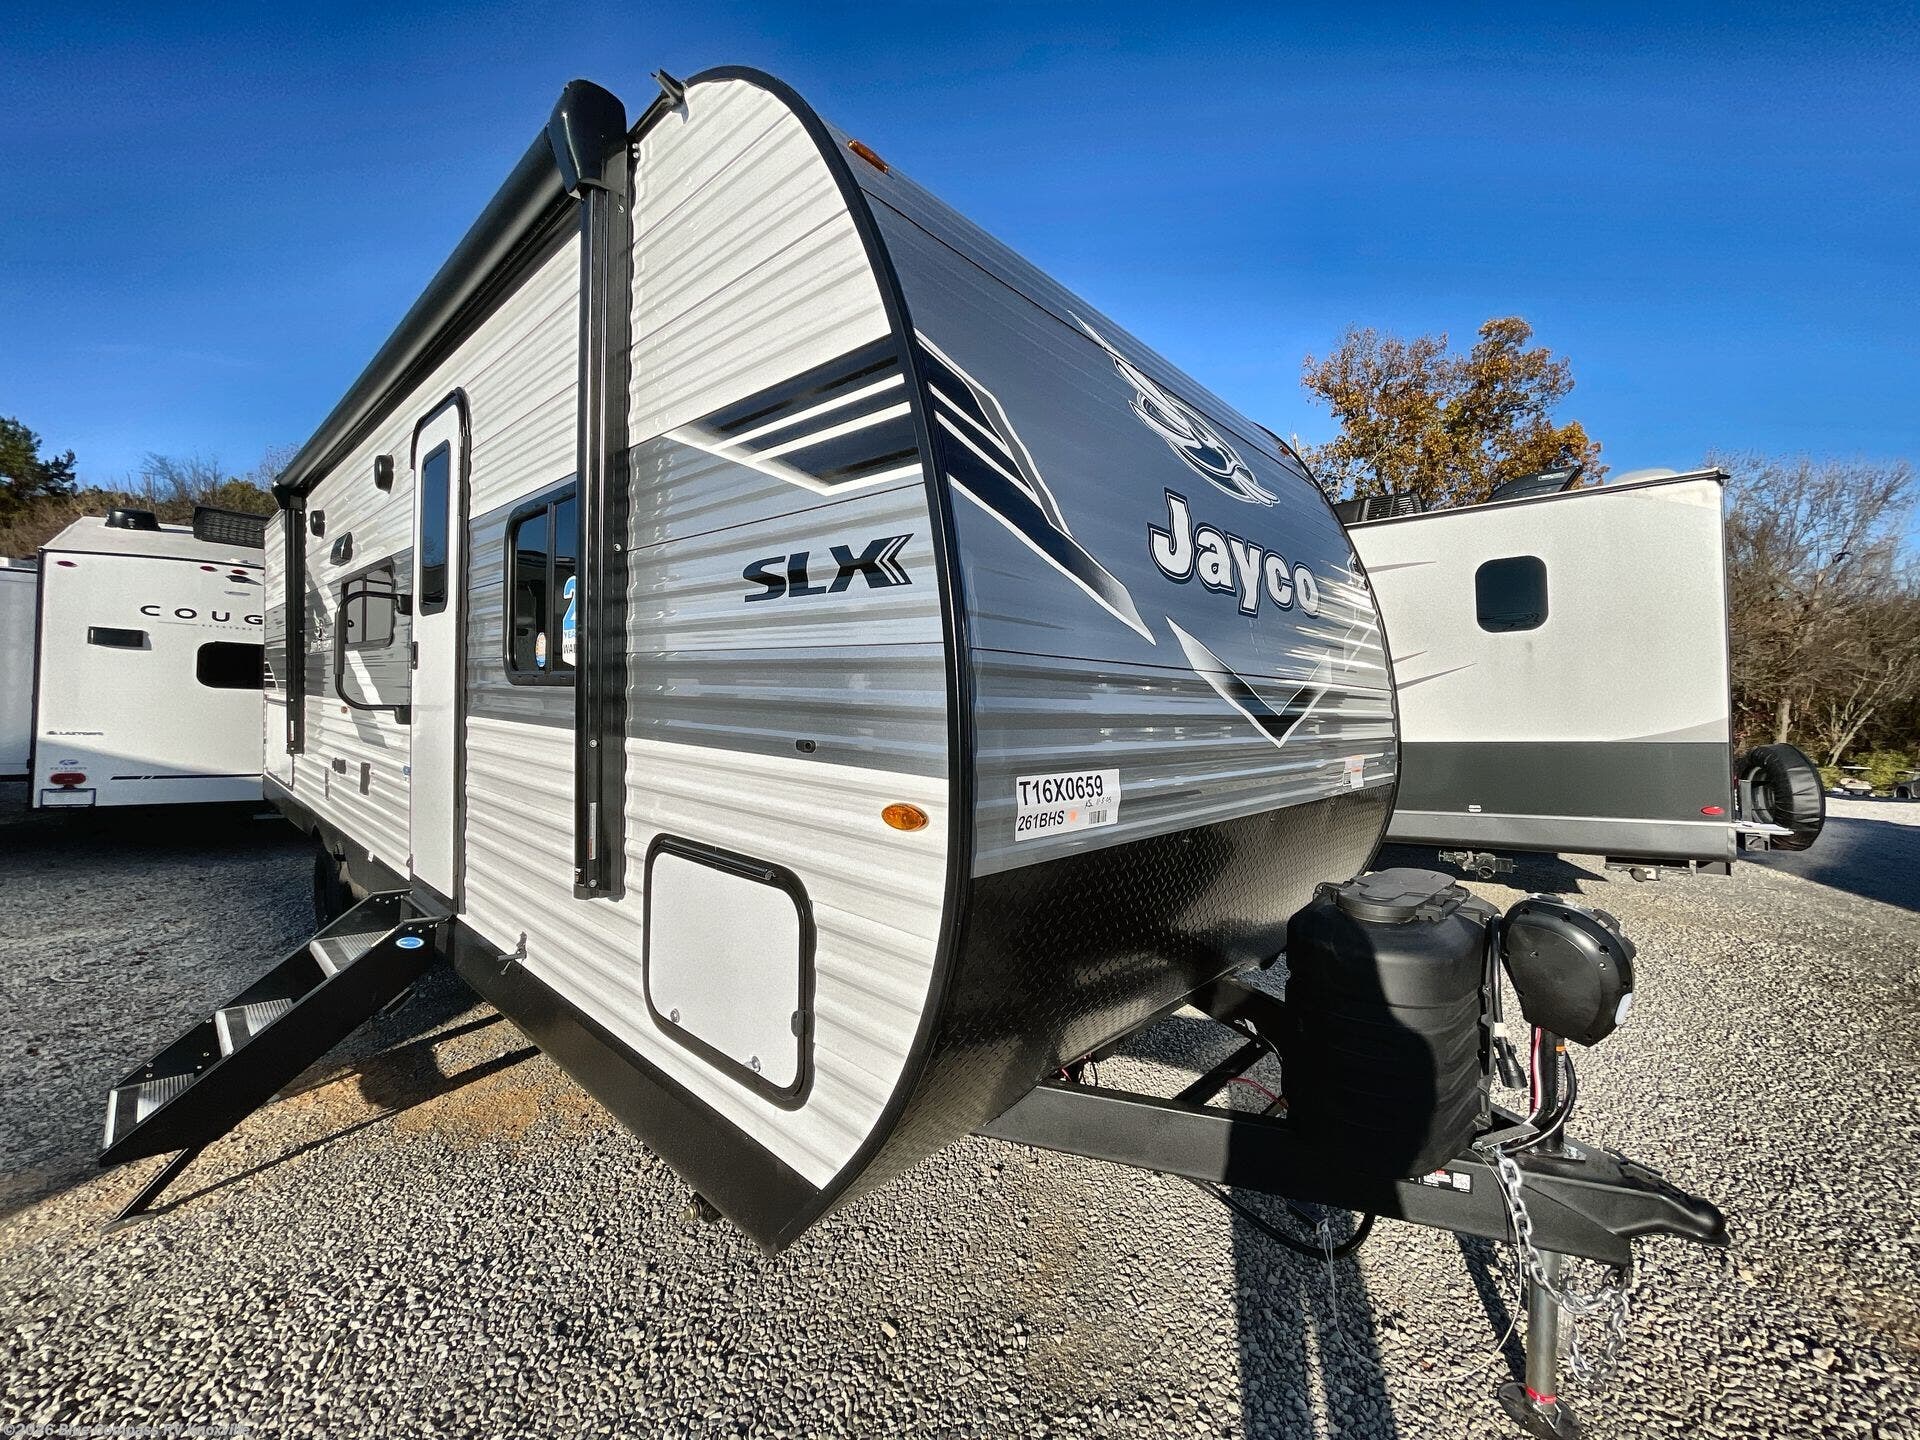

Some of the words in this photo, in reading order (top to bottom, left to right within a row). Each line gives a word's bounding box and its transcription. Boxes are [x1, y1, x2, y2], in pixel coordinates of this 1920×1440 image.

[743, 533, 915, 603] SLX
[1147, 487, 1320, 619] Jayco
[1018, 774, 1104, 806] T16X0659
[1017, 810, 1065, 832] 261BHS
